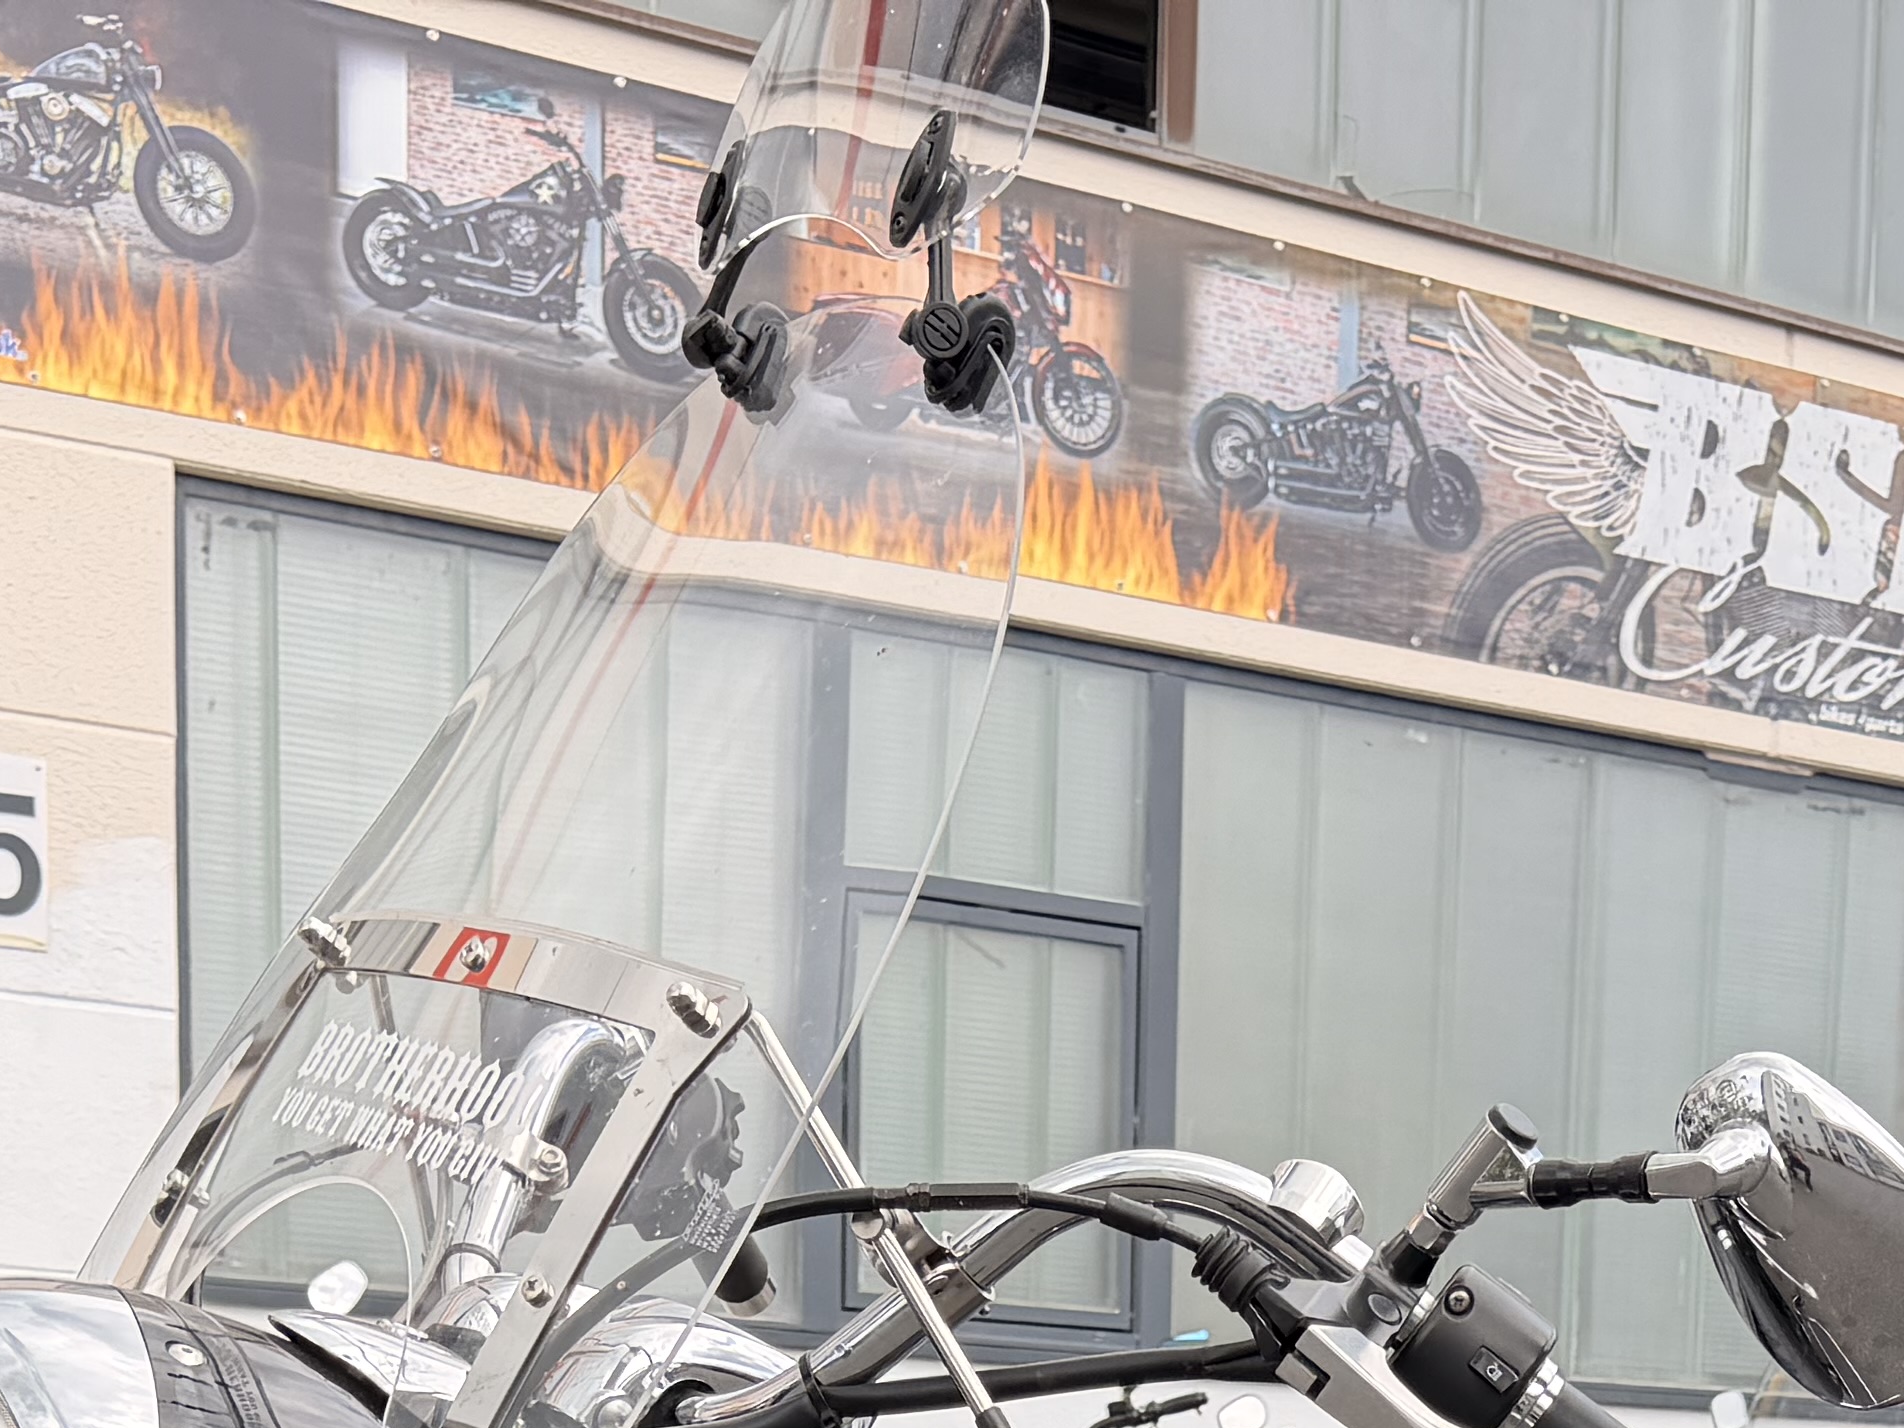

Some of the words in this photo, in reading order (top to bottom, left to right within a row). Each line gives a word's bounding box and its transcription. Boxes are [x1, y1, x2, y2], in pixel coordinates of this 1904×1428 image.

[272, 1086, 309, 1129] YOU
[304, 1090, 354, 1138] GET
[342, 1104, 415, 1157] WHAT
[404, 1122, 461, 1171] YOU
